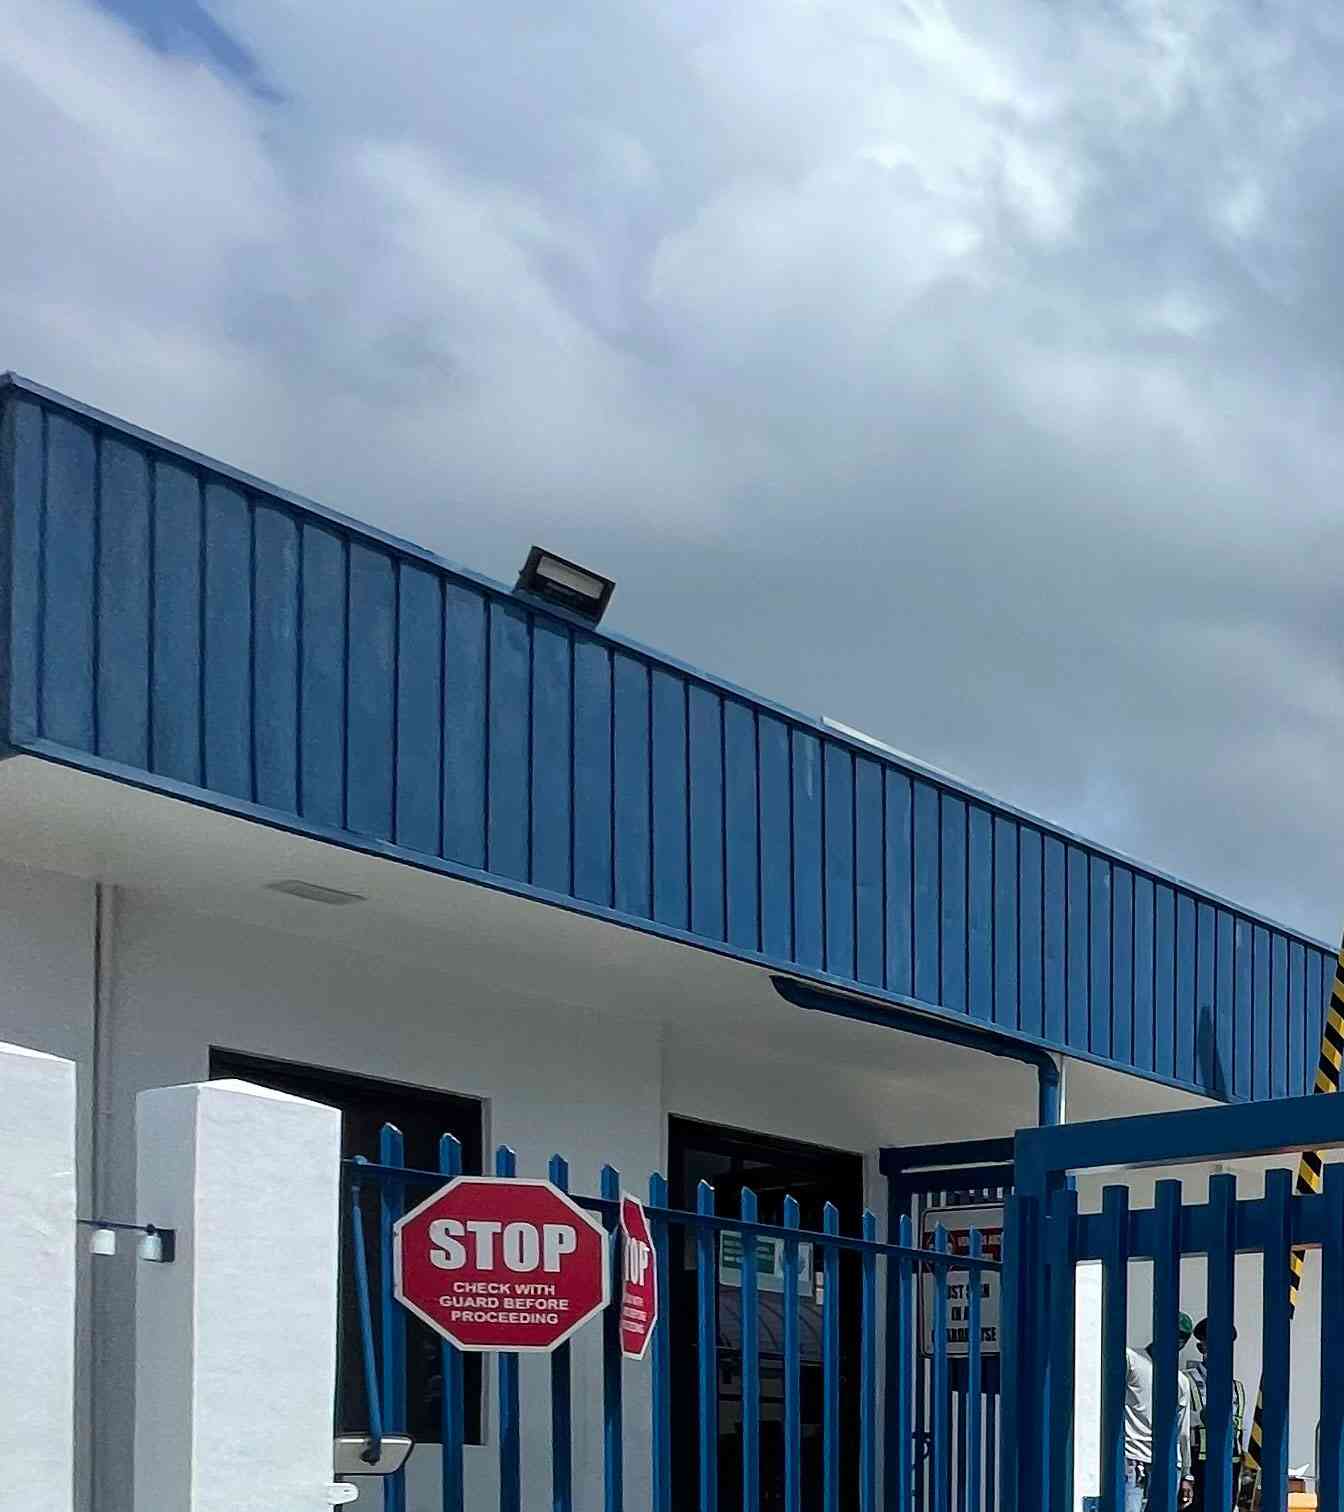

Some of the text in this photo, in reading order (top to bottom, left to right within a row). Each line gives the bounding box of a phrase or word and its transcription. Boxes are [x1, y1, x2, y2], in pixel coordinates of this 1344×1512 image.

[428, 1219, 577, 1273] STOP
[624, 1237, 650, 1287] TOP
[453, 1281, 555, 1295] CHECK WITH
[439, 1295, 569, 1310] GUARD BEFORE
[451, 1310, 558, 1324] PROCEEDING
